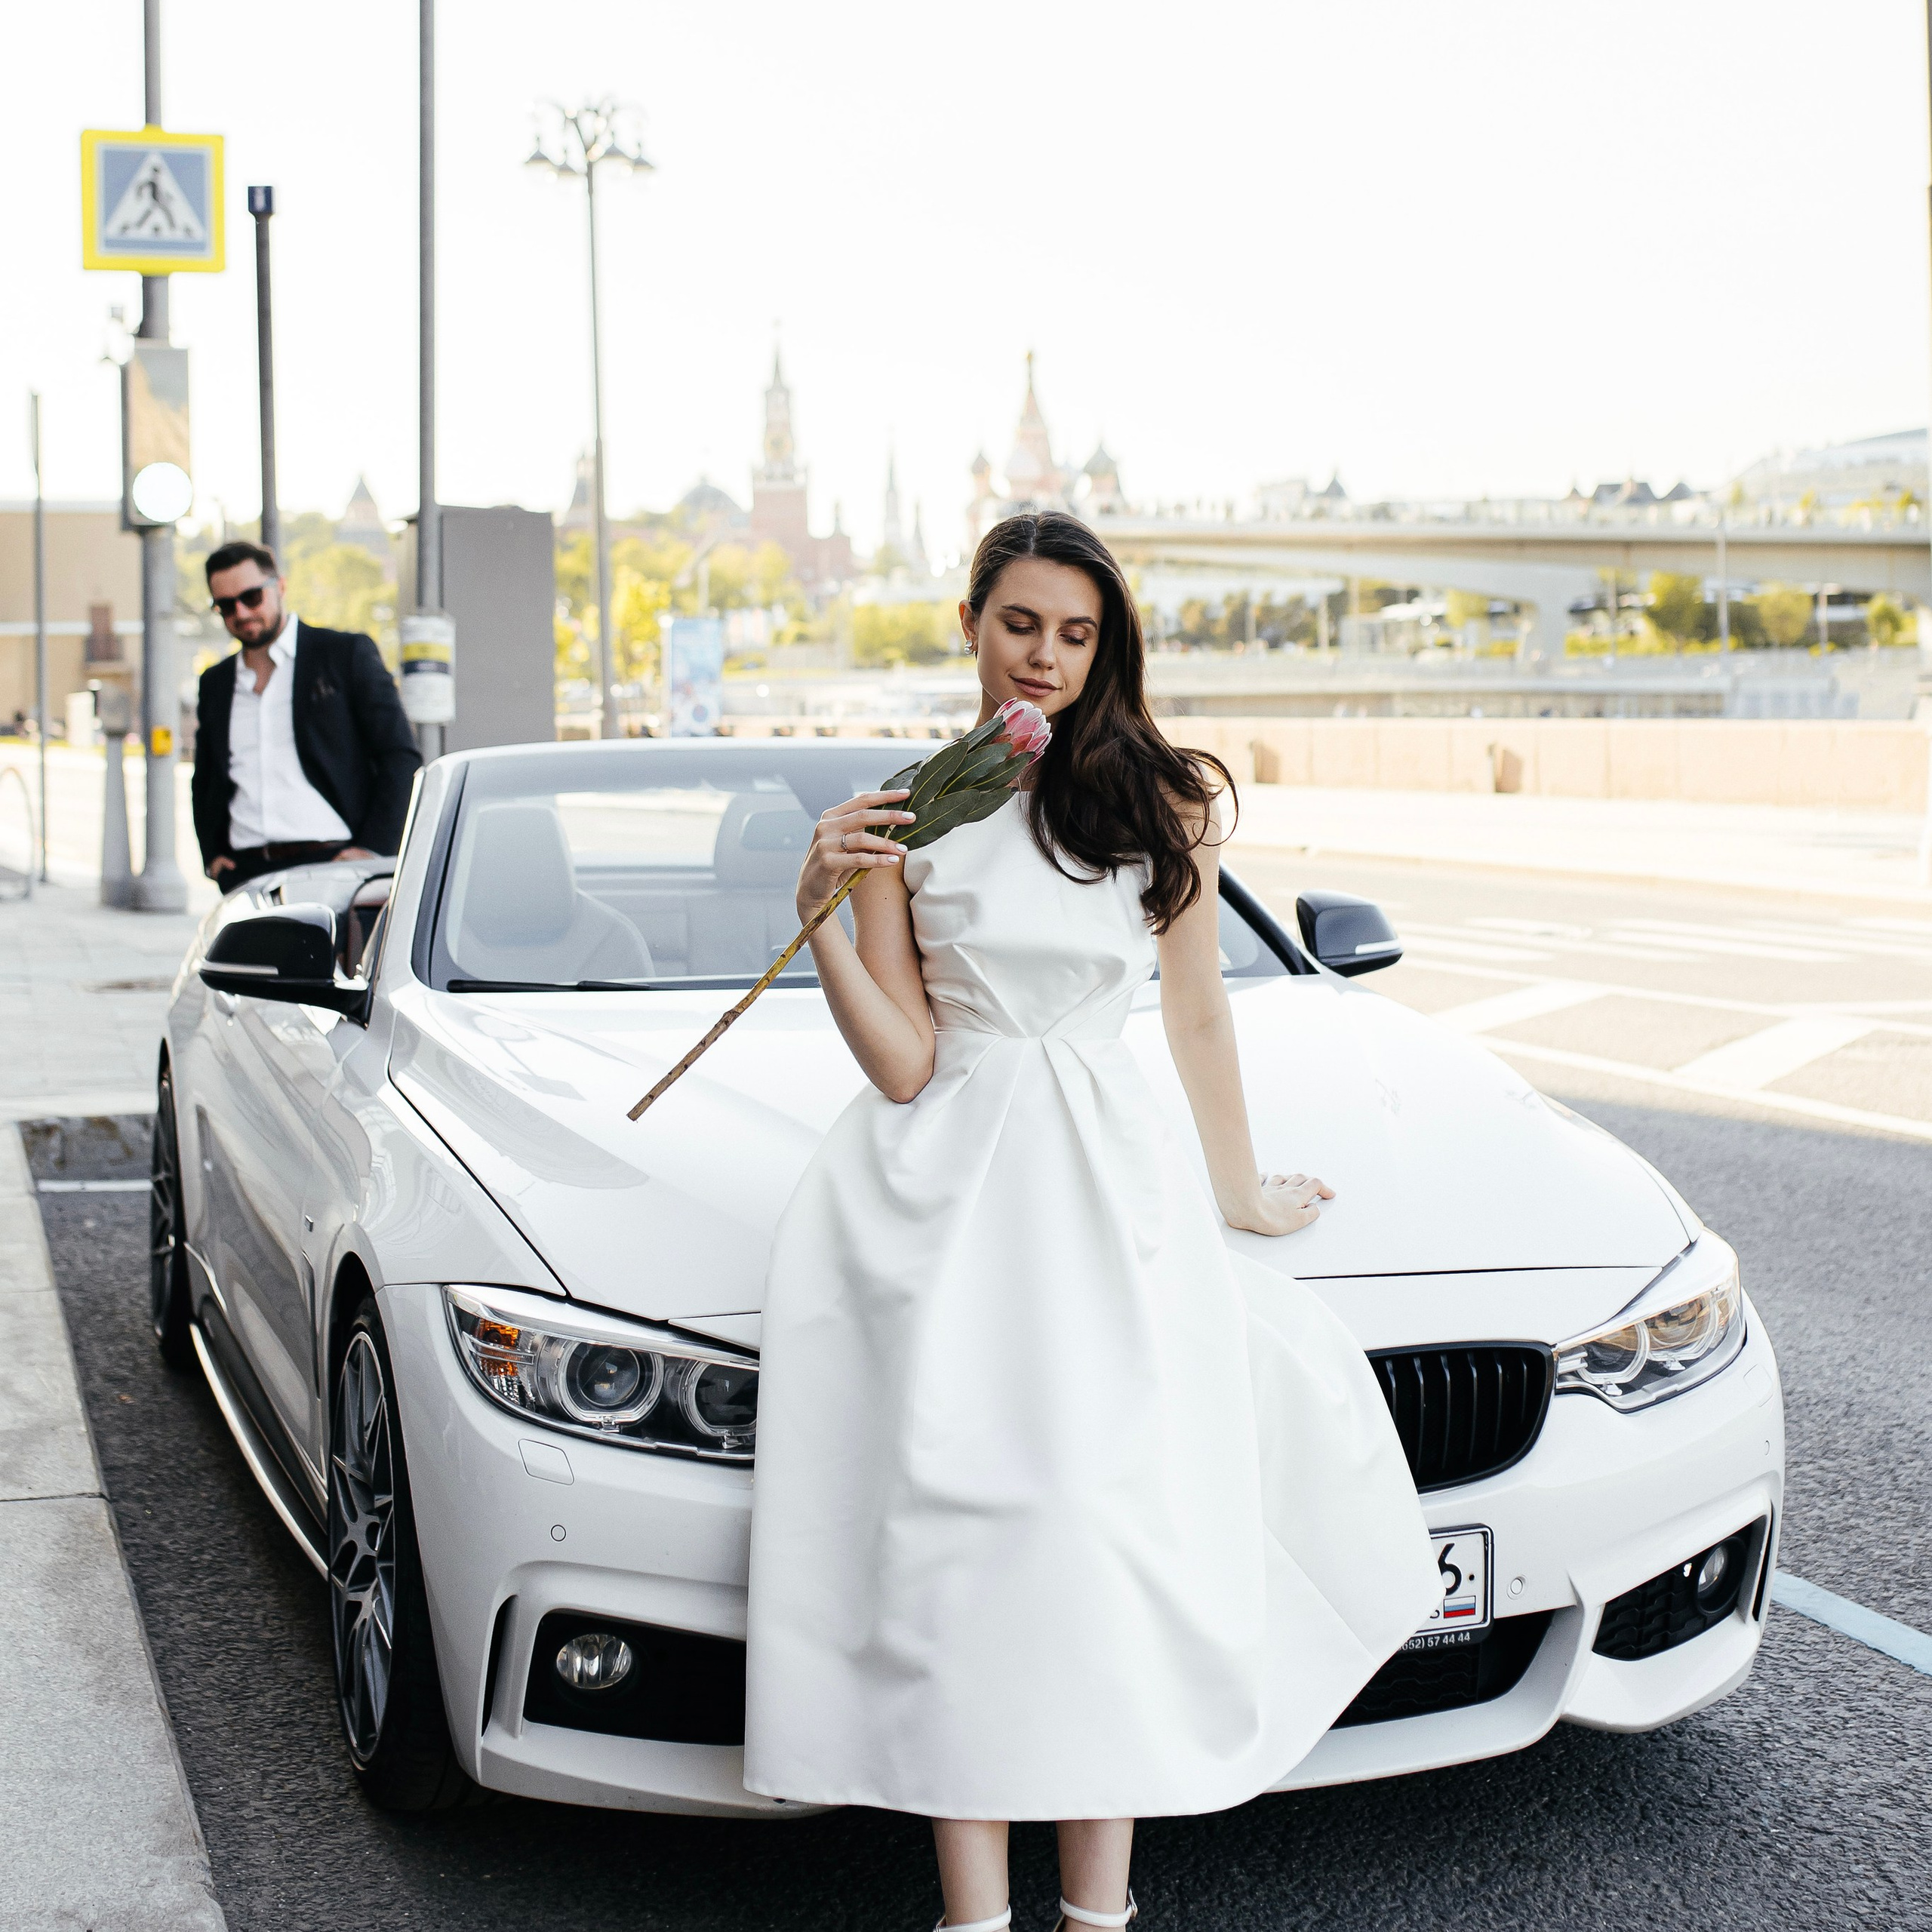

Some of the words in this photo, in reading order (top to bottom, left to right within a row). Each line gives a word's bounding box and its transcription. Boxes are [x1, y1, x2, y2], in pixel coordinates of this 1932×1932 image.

[1438, 1543, 1462, 1596] 6
[1398, 1637, 1425, 1651] 652)
[1427, 1635, 1440, 1647] 57
[1442, 1634, 1455, 1645] 44
[1457, 1632, 1471, 1642] 44
